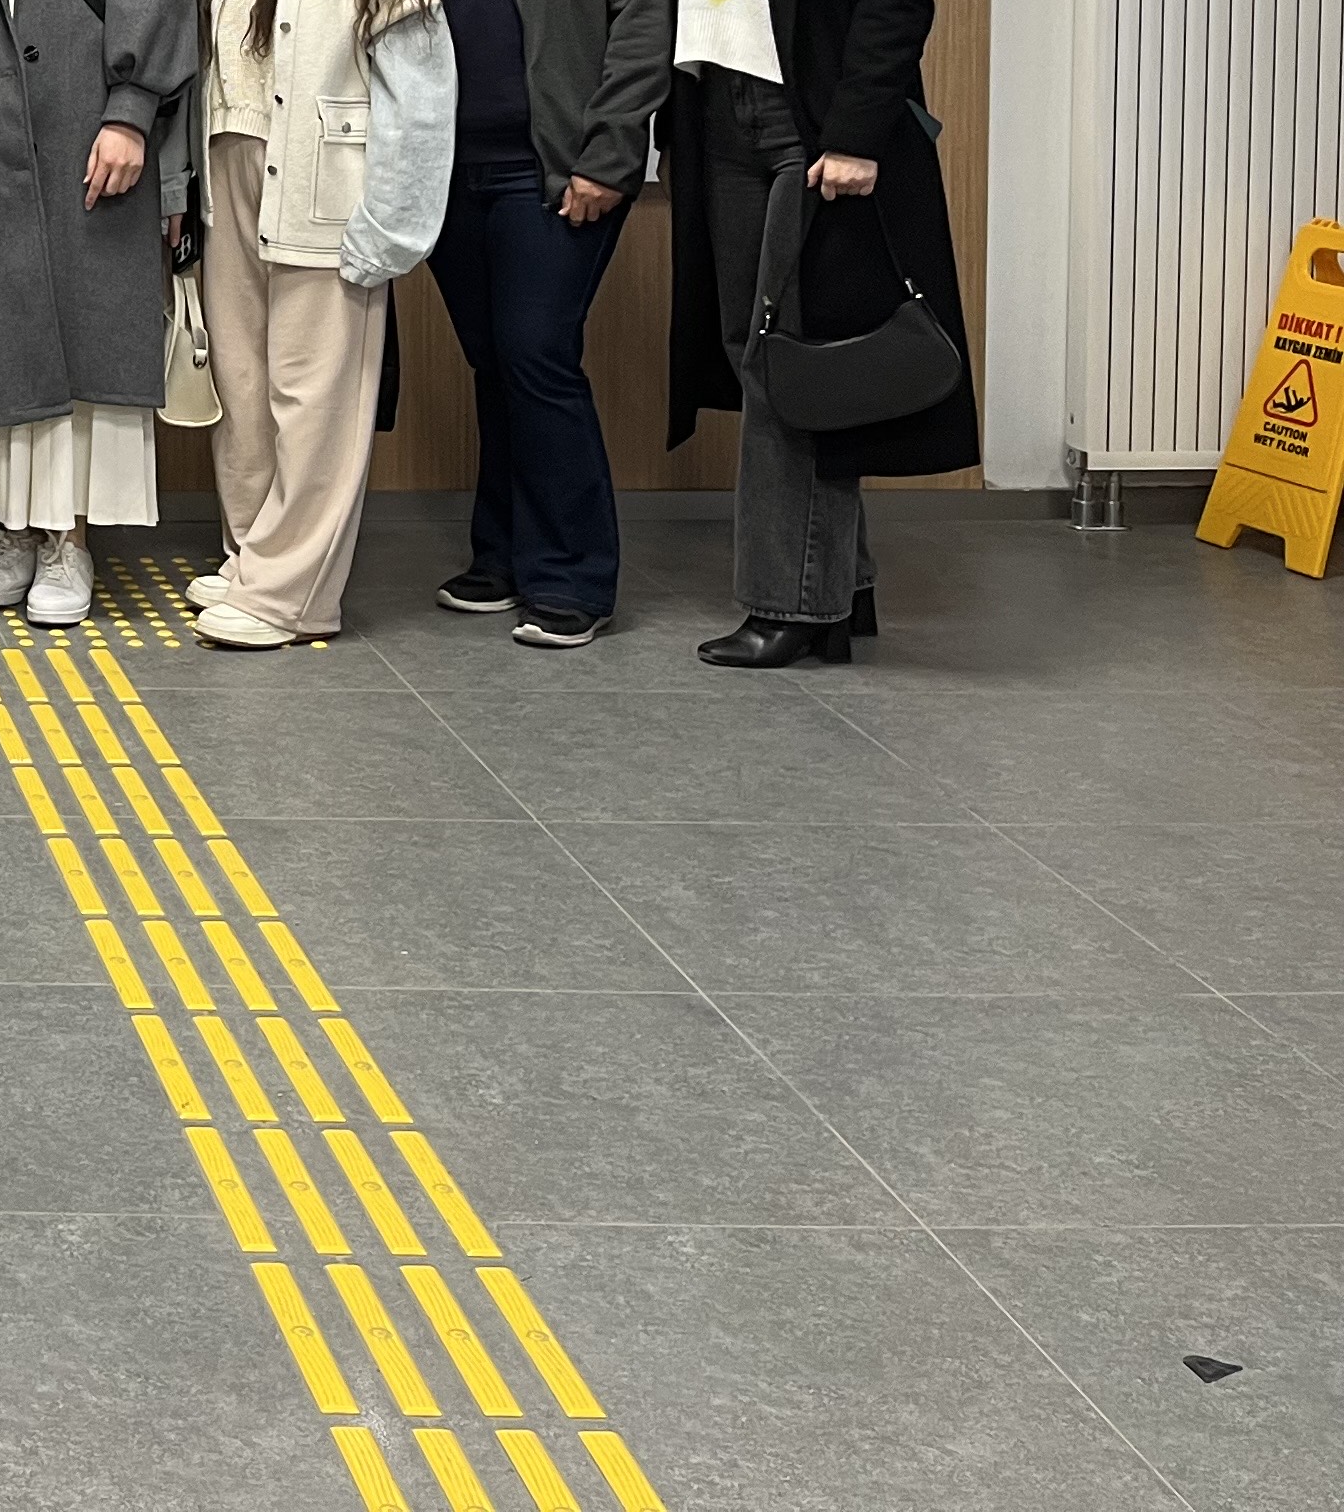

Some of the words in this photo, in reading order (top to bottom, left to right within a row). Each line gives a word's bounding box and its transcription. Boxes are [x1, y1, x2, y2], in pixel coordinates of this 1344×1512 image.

[1277, 312, 1335, 341] DİKKAT
[1263, 421, 1308, 443] CAUTION
[1253, 433, 1276, 448] WET
[1275, 439, 1310, 458] FLOOR
